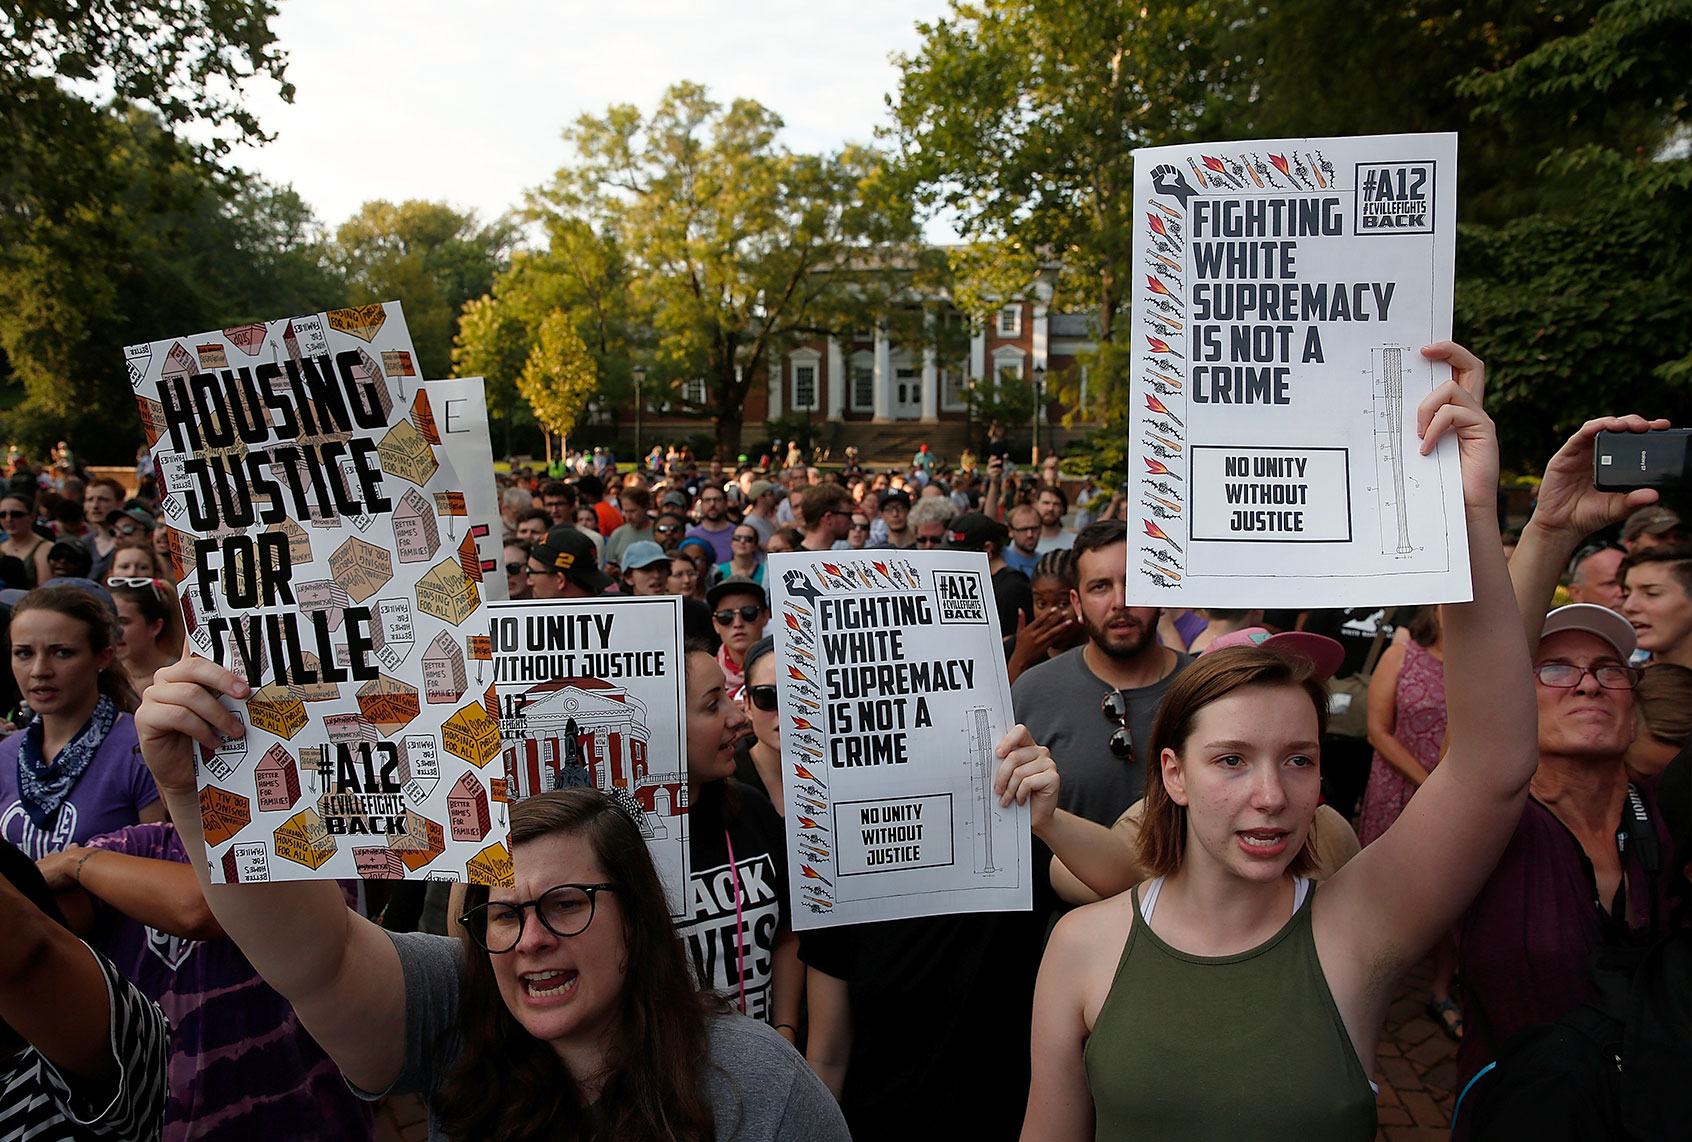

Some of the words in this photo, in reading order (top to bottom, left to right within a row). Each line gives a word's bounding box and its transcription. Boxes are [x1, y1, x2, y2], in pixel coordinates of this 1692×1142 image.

[1363, 168, 1426, 201] #A12
[1363, 201, 1427, 215] #CVILLEFIGHTS
[1192, 198, 1343, 237] FIGHTING
[1363, 214, 1426, 228] BACK
[1193, 241, 1297, 279] WHITE
[1193, 282, 1396, 321] SUPREMACY
[294, 321, 320, 334] FAMILIES
[331, 317, 345, 330] FOR
[346, 321, 361, 334] ALL
[234, 332, 250, 346] STOP
[310, 331, 323, 341] FOR
[1192, 325, 1222, 361] IS
[1230, 325, 1294, 362] NOT
[1302, 326, 1325, 363] A
[1192, 366, 1290, 404] CRIME
[155, 351, 389, 453] HOUSING
[381, 451, 413, 467] HOUSING
[1225, 457, 1249, 477] NO
[1253, 457, 1307, 477] UNITY
[384, 462, 398, 473] FOR
[400, 465, 415, 479] ALL
[172, 480, 192, 489] BETTER
[184, 437, 392, 532] JUSTICE
[1225, 484, 1308, 504] WITHOUT
[395, 519, 416, 530] BETTER
[1231, 511, 1304, 532] JUSTICE
[282, 524, 298, 536] STOP
[397, 529, 418, 537] HOMES
[358, 543, 373, 556] ALL
[399, 539, 411, 547] FOR
[375, 548, 388, 561] FOR
[400, 546, 428, 557] FAMILIES
[359, 555, 391, 572] HOUSING
[554, 552, 575, 569] 2
[194, 532, 296, 611] FOR
[940, 576, 979, 600] #A12
[417, 588, 450, 606] HOUSING
[455, 588, 475, 606] PUBLIC
[943, 599, 982, 610] #CVILLEFIGHTS
[380, 604, 408, 614] FAMILIES
[419, 600, 434, 613] FOR
[435, 605, 451, 618] ALL
[819, 595, 933, 631] FIGHTING
[944, 609, 983, 619] BACK
[396, 614, 409, 622] FOR
[389, 623, 411, 632] HOMES
[526, 614, 614, 651] UNITY
[390, 632, 412, 640] BETTER
[208, 606, 379, 688] CVILLE
[822, 630, 904, 665] WHITE
[424, 662, 445, 671] BETTER
[582, 651, 665, 678] JUSTICE
[425, 670, 447, 679] HOMES
[825, 659, 974, 699] SUPREMACY
[386, 680, 401, 692] ALL
[427, 680, 439, 688] FOR
[404, 686, 417, 699] FOR
[428, 688, 455, 698] FAMILIES
[386, 693, 417, 709] HOUSING
[497, 693, 527, 719] 12
[249, 705, 280, 722] HOUSING
[285, 708, 302, 724] PUBLIC
[828, 702, 853, 734] IS
[858, 698, 908, 732] NOT
[914, 696, 932, 728] A
[252, 717, 265, 728] FOR
[267, 720, 282, 733] ALL
[469, 717, 497, 737] SUPPORT
[444, 729, 475, 748] HOUSING
[479, 732, 498, 750] PUBLIC
[500, 729, 528, 739] CK
[221, 742, 245, 751] BETTER
[407, 741, 434, 749] FAMILIES
[445, 741, 459, 753] FOR
[461, 747, 475, 760] ALL
[830, 733, 908, 768] CRIME
[422, 751, 434, 759] FOR
[317, 742, 401, 794] #A12
[415, 759, 436, 768] HOMES
[257, 771, 280, 780] BETTER
[416, 768, 438, 776] BETTER
[259, 779, 280, 788] HOMES
[216, 791, 230, 804] ALL
[234, 796, 247, 809] FOR
[260, 796, 289, 806] FAMILIES
[324, 794, 406, 815] #CVILLEFIGHTS
[449, 800, 471, 808] BETTER
[215, 802, 249, 818] HOUSING
[451, 808, 472, 817] HOMES
[860, 808, 879, 825] NO
[882, 804, 923, 823] UNITY
[203, 814, 223, 832] SUPP
[325, 816, 408, 836] BACK
[413, 816, 427, 829] ALL
[428, 822, 441, 836] FOR
[453, 818, 465, 826] FOR
[413, 828, 444, 846] HOUSING
[453, 828, 480, 836] FAMILIES
[861, 824, 923, 845] WITHOUT
[276, 834, 308, 852] HOUSING
[313, 837, 331, 851] PUBLIC
[235, 847, 264, 857] FAMILIES
[277, 845, 291, 857] FOR
[293, 849, 308, 862] ALL
[866, 845, 921, 866] JUSTICE
[252, 857, 265, 865] FOR
[244, 865, 267, 874] HOMES
[245, 873, 268, 881] BETTER
[468, 868, 497, 886] HOUSING
[690, 862, 776, 919] ACK
[687, 913, 776, 989] VES
